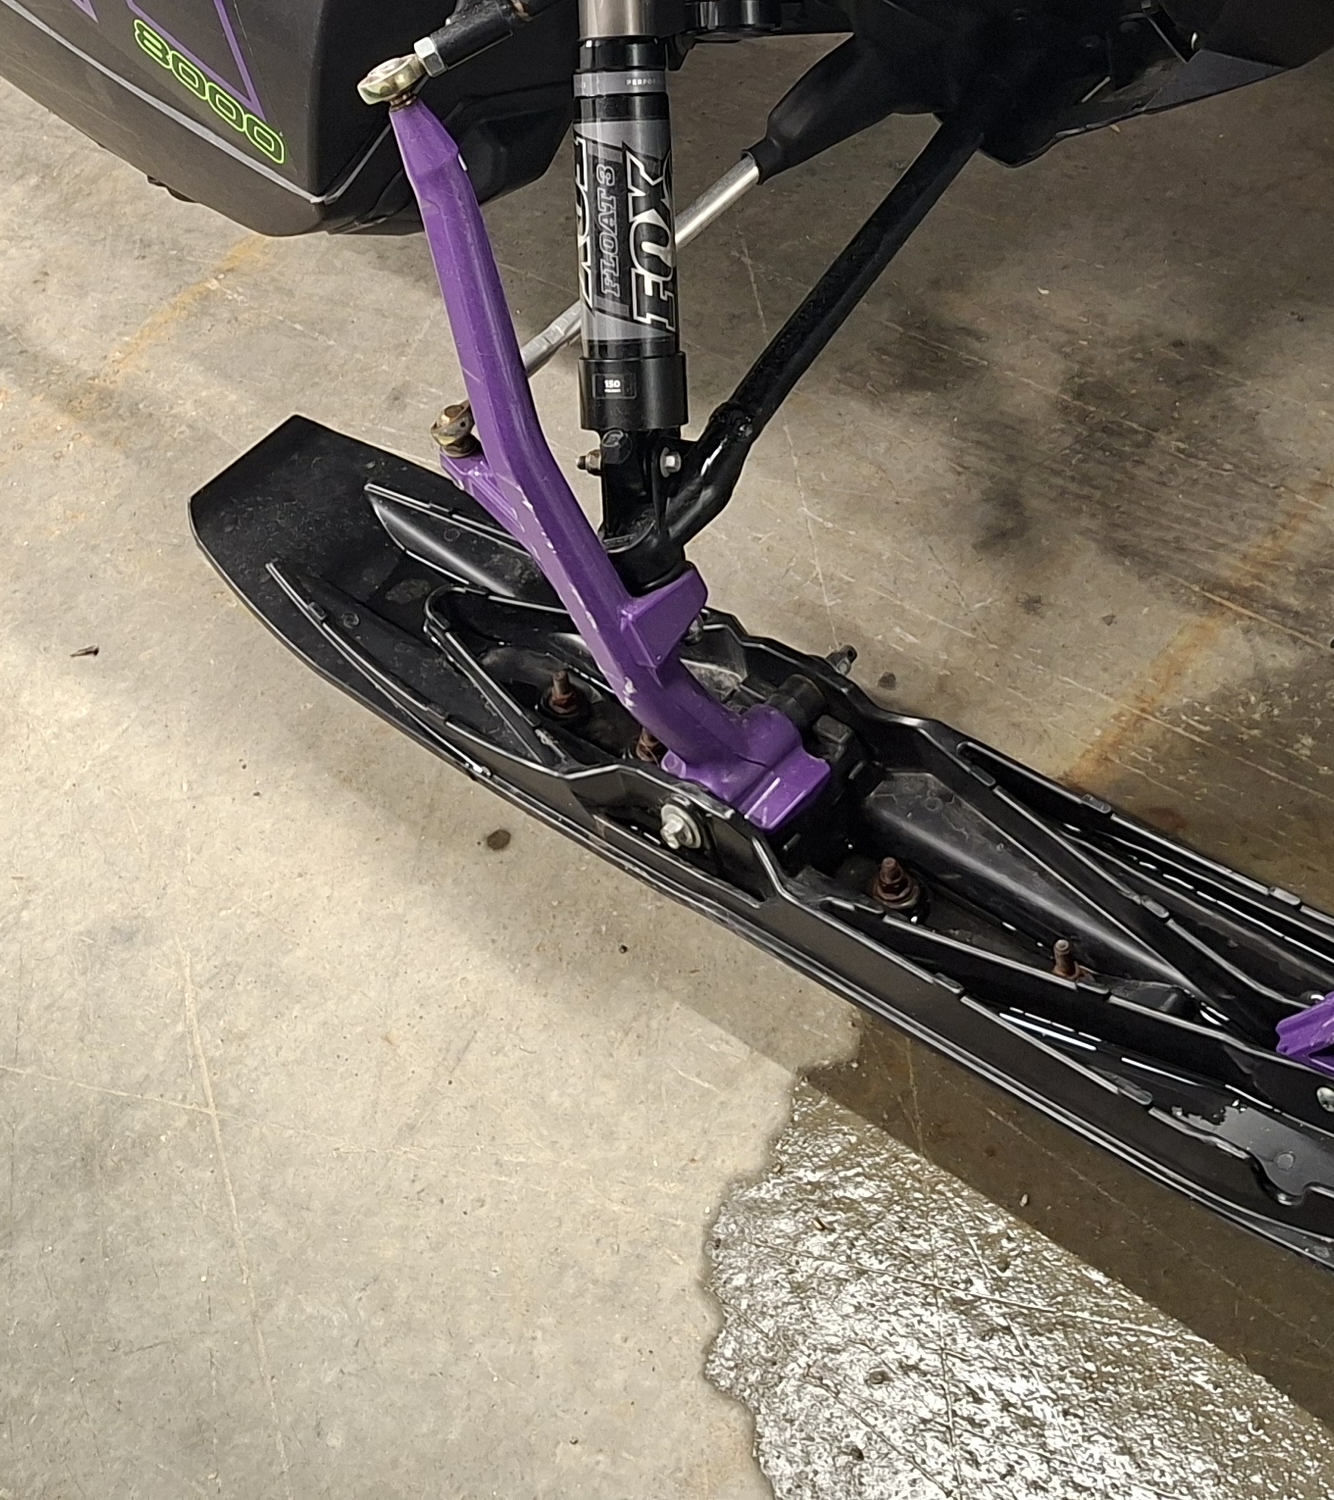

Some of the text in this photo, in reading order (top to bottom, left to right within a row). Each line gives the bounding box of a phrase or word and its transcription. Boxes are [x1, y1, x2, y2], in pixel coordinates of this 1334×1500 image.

[596, 164, 621, 298] FLOAT 3
[625, 149, 677, 333] FOX
